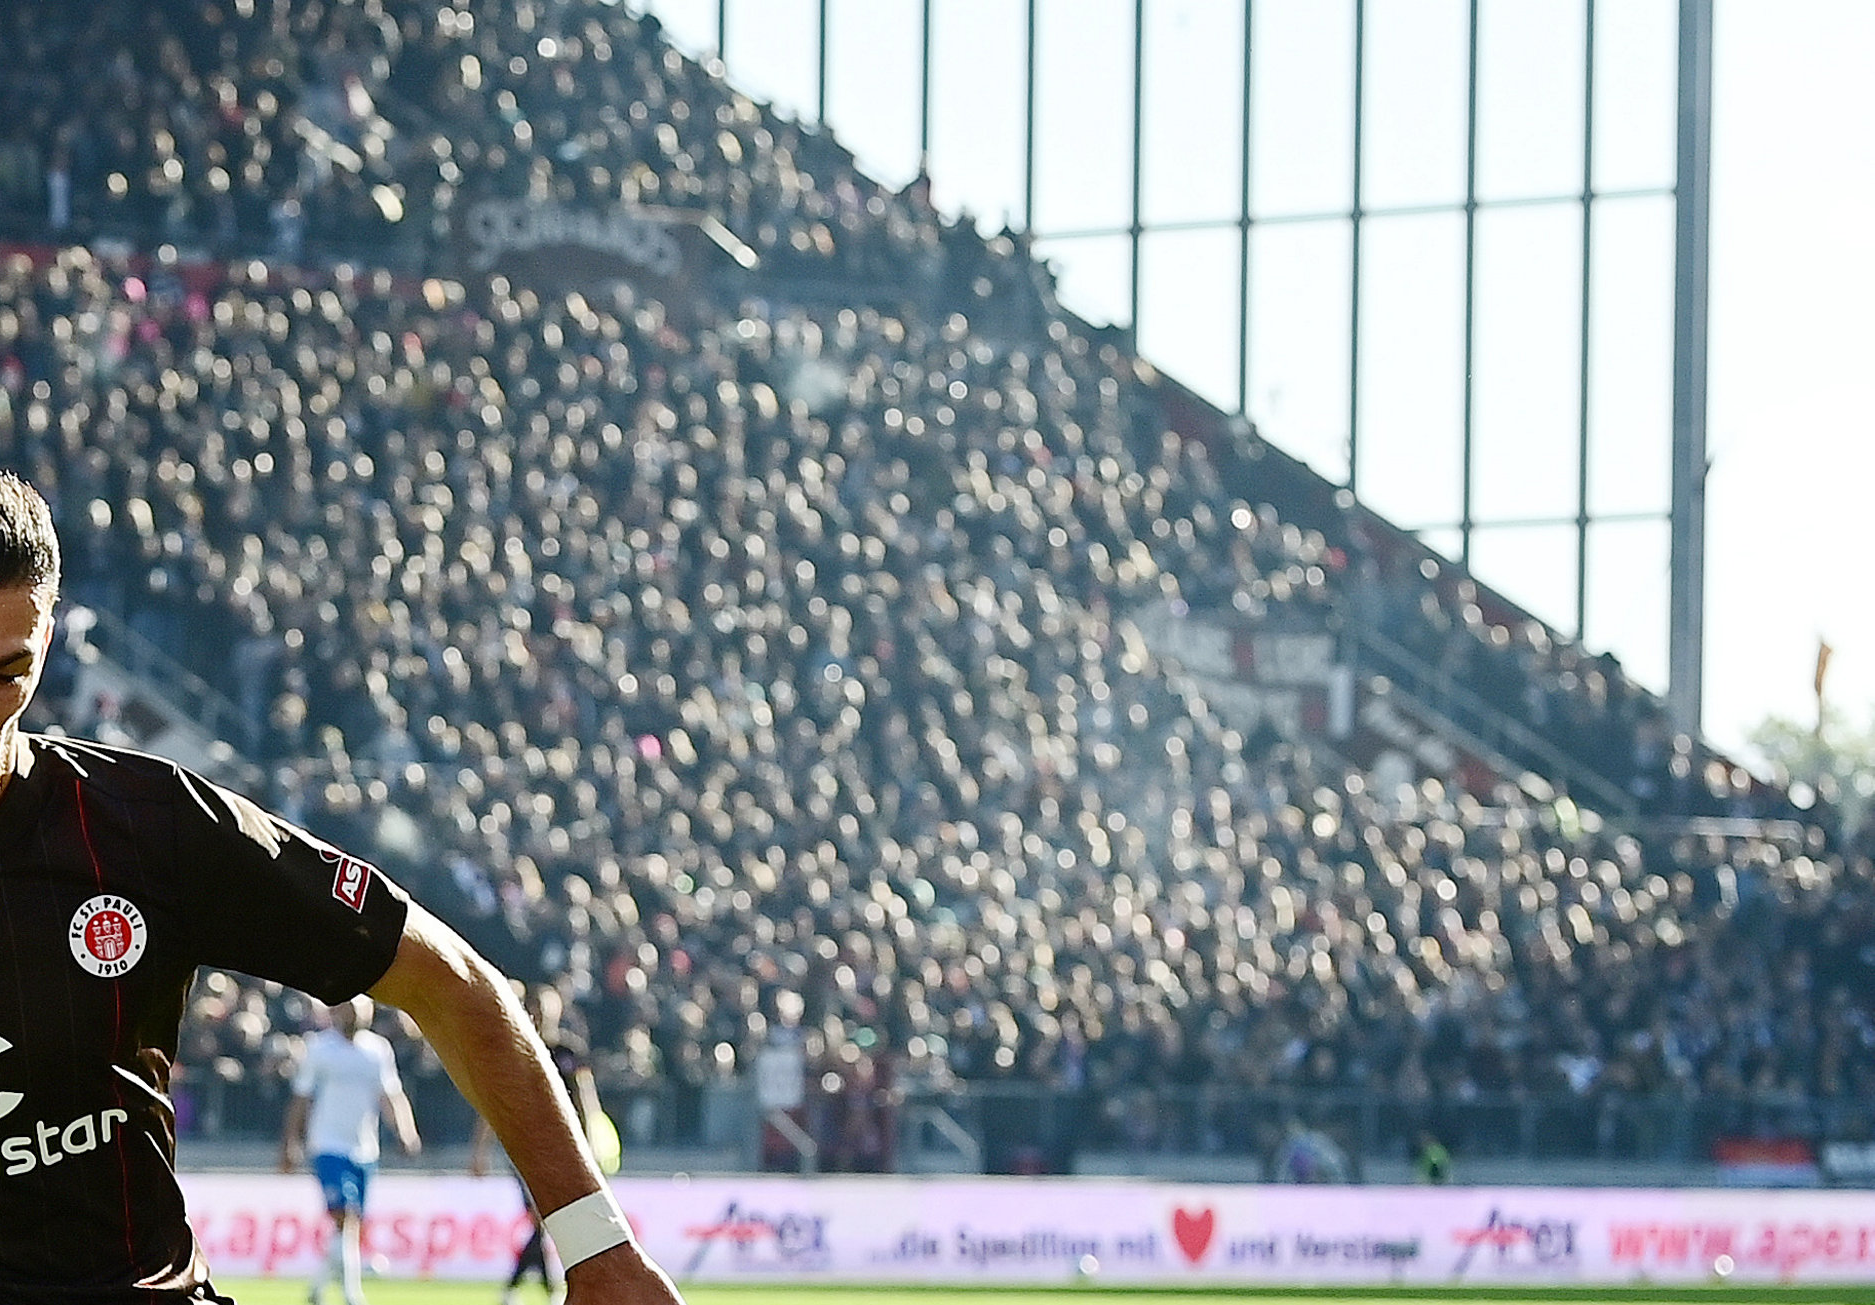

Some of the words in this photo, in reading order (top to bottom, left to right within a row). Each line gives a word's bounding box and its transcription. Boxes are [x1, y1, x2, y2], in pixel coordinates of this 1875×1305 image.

[71, 922, 84, 939] FC
[79, 902, 100, 919] ST.
[103, 896, 144, 930] PAULI
[97, 959, 129, 976] 1910
